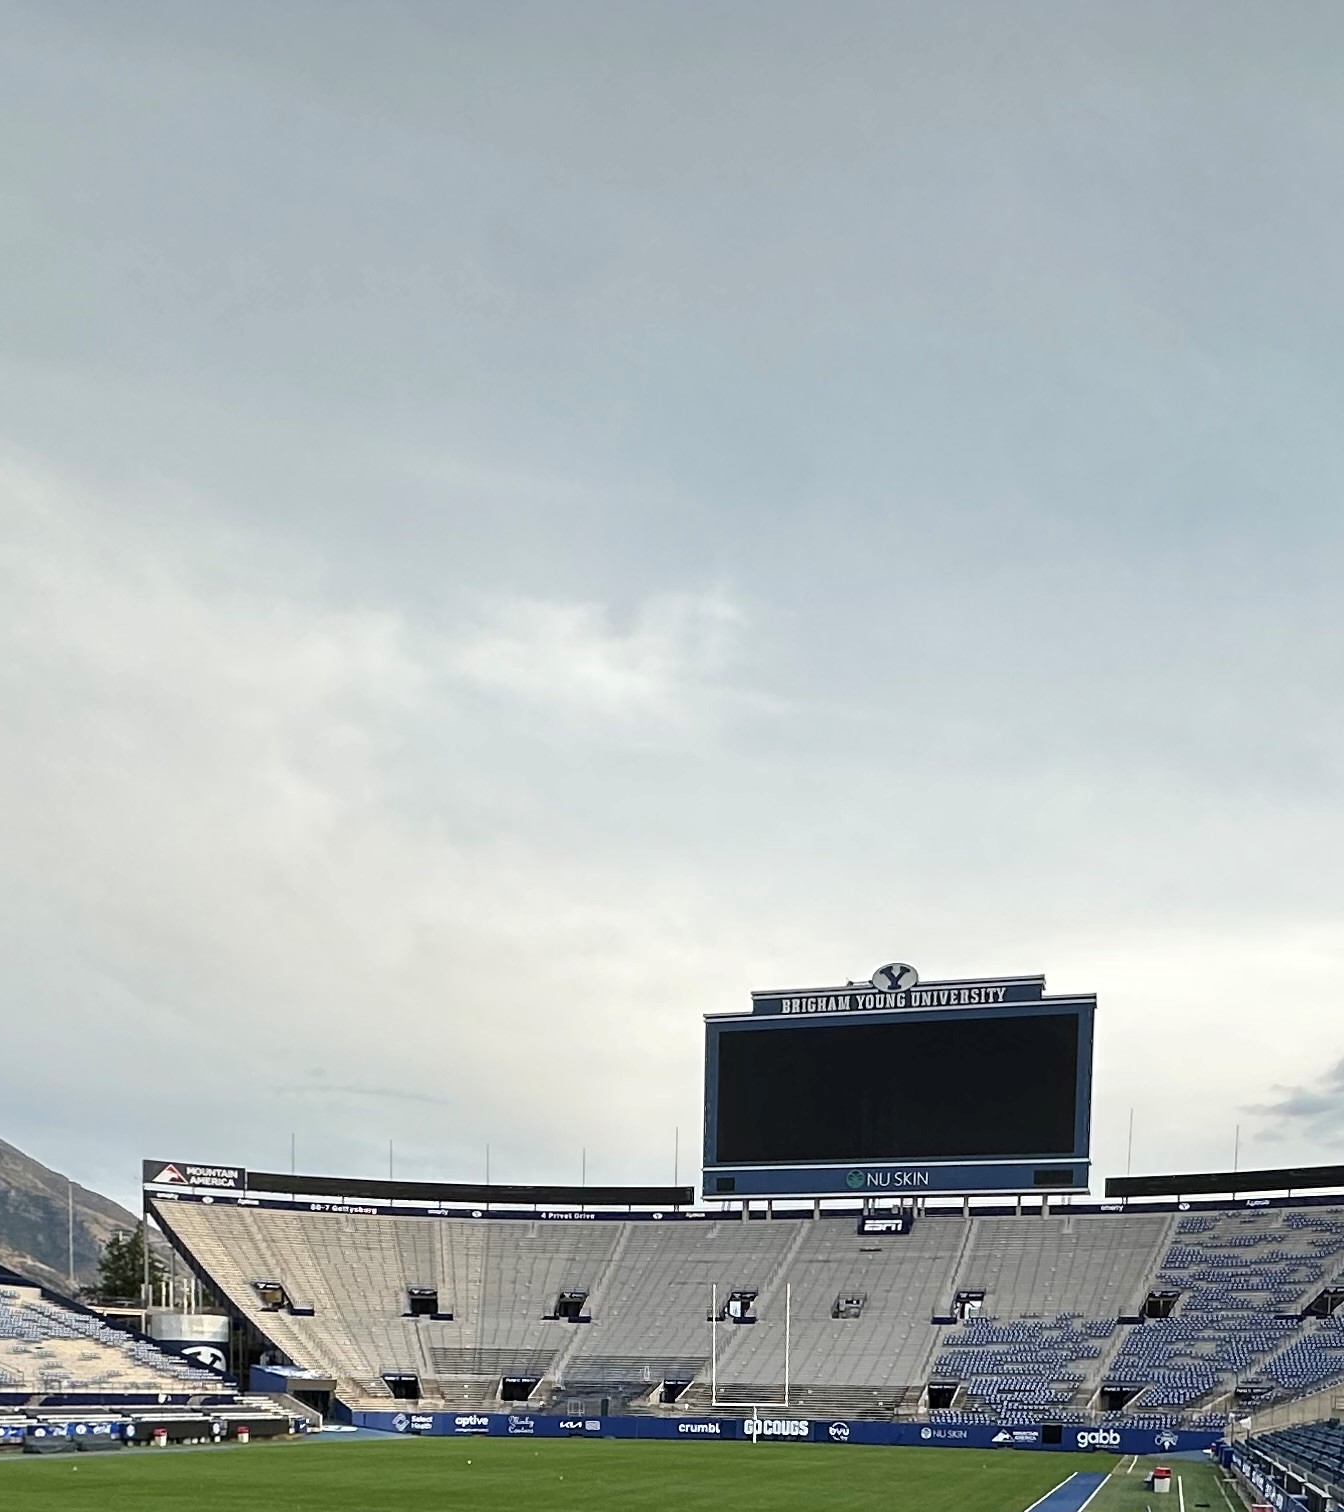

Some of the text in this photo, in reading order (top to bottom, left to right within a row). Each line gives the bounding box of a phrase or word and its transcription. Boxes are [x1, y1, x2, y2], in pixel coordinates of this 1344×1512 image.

[878, 966, 911, 989] Y
[781, 987, 1006, 1014] BRIGHAM YOUNG UNIVERSITY
[186, 1167, 238, 1179] MOUNTAIN
[867, 1171, 929, 1187] NU SKIN
[189, 1175, 236, 1187] AMERICA
[863, 1219, 903, 1231] ESPN
[455, 1414, 489, 1427] aptive
[743, 1419, 809, 1436] GO COUGS
[678, 1422, 721, 1434] crumbl
[1077, 1427, 1121, 1446] gabb
